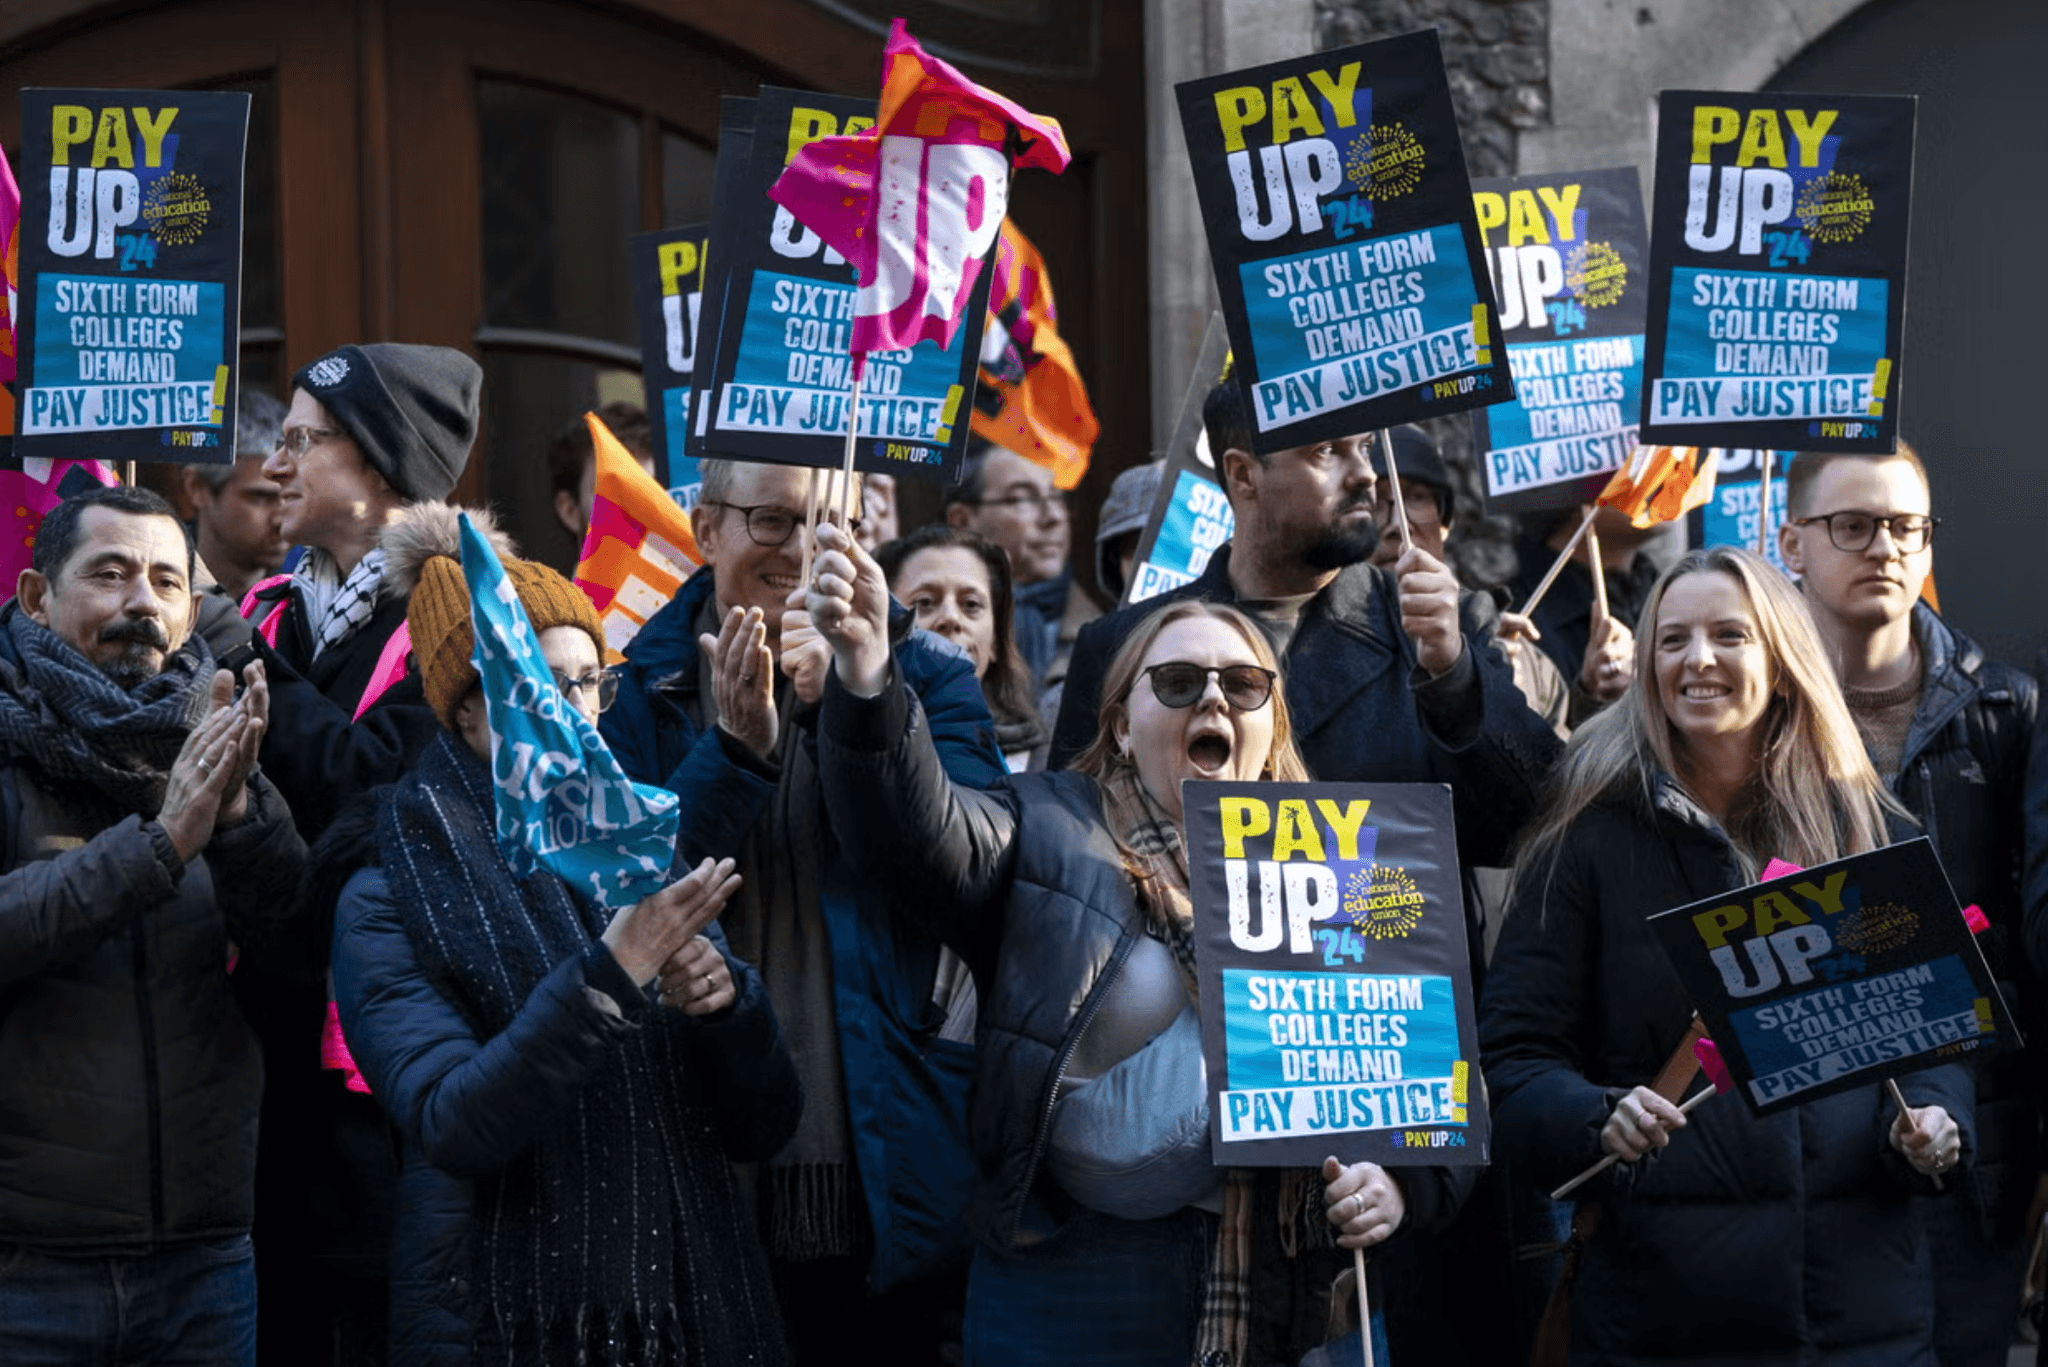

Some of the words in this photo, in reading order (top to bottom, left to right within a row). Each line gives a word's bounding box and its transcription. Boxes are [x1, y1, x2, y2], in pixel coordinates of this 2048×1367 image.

[1214, 61, 1362, 152] PAY
[51, 104, 179, 168] PAY
[1362, 139, 1400, 161] national
[1691, 106, 1839, 169] PAY
[1347, 139, 1425, 182] education
[1375, 165, 1403, 183] union
[142, 199, 211, 219] education
[1227, 138, 1342, 241] UP
[1684, 164, 1794, 255] UP
[1796, 197, 1875, 218] education
[47, 166, 140, 259] UP
[1472, 184, 1581, 248] PAY
[1264, 249, 1351, 298] SIXTH
[1358, 230, 1436, 277] FORM
[55, 280, 127, 314] SIXTH
[135, 283, 199, 316] FORM
[1288, 272, 1425, 328] COLLEGES
[1692, 274, 1777, 308] SIXTH
[1786, 278, 1859, 310] FORM
[69, 316, 183, 351] COLLEGES
[1304, 307, 1424, 362] DEMAND
[1708, 309, 1840, 344] COLLEGES
[79, 351, 176, 383] DEMAND
[1573, 337, 1634, 373] FORM
[1715, 343, 1829, 376] DEMAND
[31, 386, 86, 427] PAY
[726, 386, 793, 427] PAY
[1258, 369, 1335, 422] PAY
[1517, 371, 1624, 410] COLLEGES
[1660, 380, 1723, 418] PAY
[1529, 402, 1623, 440] DEMAND
[1492, 446, 1543, 487] PAY
[1219, 796, 1371, 861] PAY
[1225, 859, 1339, 954] UP
[1344, 889, 1425, 914] education
[1361, 880, 1400, 895] national
[1371, 908, 1402, 921] union
[1692, 871, 1847, 949] PAY
[1709, 924, 1832, 998] UP
[1247, 976, 1336, 1011] SIXTH
[1345, 977, 1423, 1011] FORM
[1754, 986, 1846, 1030] SIXTH
[1853, 964, 1935, 997] FORM
[1268, 1013, 1408, 1047] COLLEGES
[1782, 988, 1924, 1044] COLLEGES
[1800, 1009, 1925, 1059] DEMAND
[1281, 1049, 1402, 1083] DEMAND
[1755, 1060, 1824, 1099] PAY
[1227, 1092, 1297, 1132] PAY
[1307, 1060, 1469, 1129] JUSTICE!
